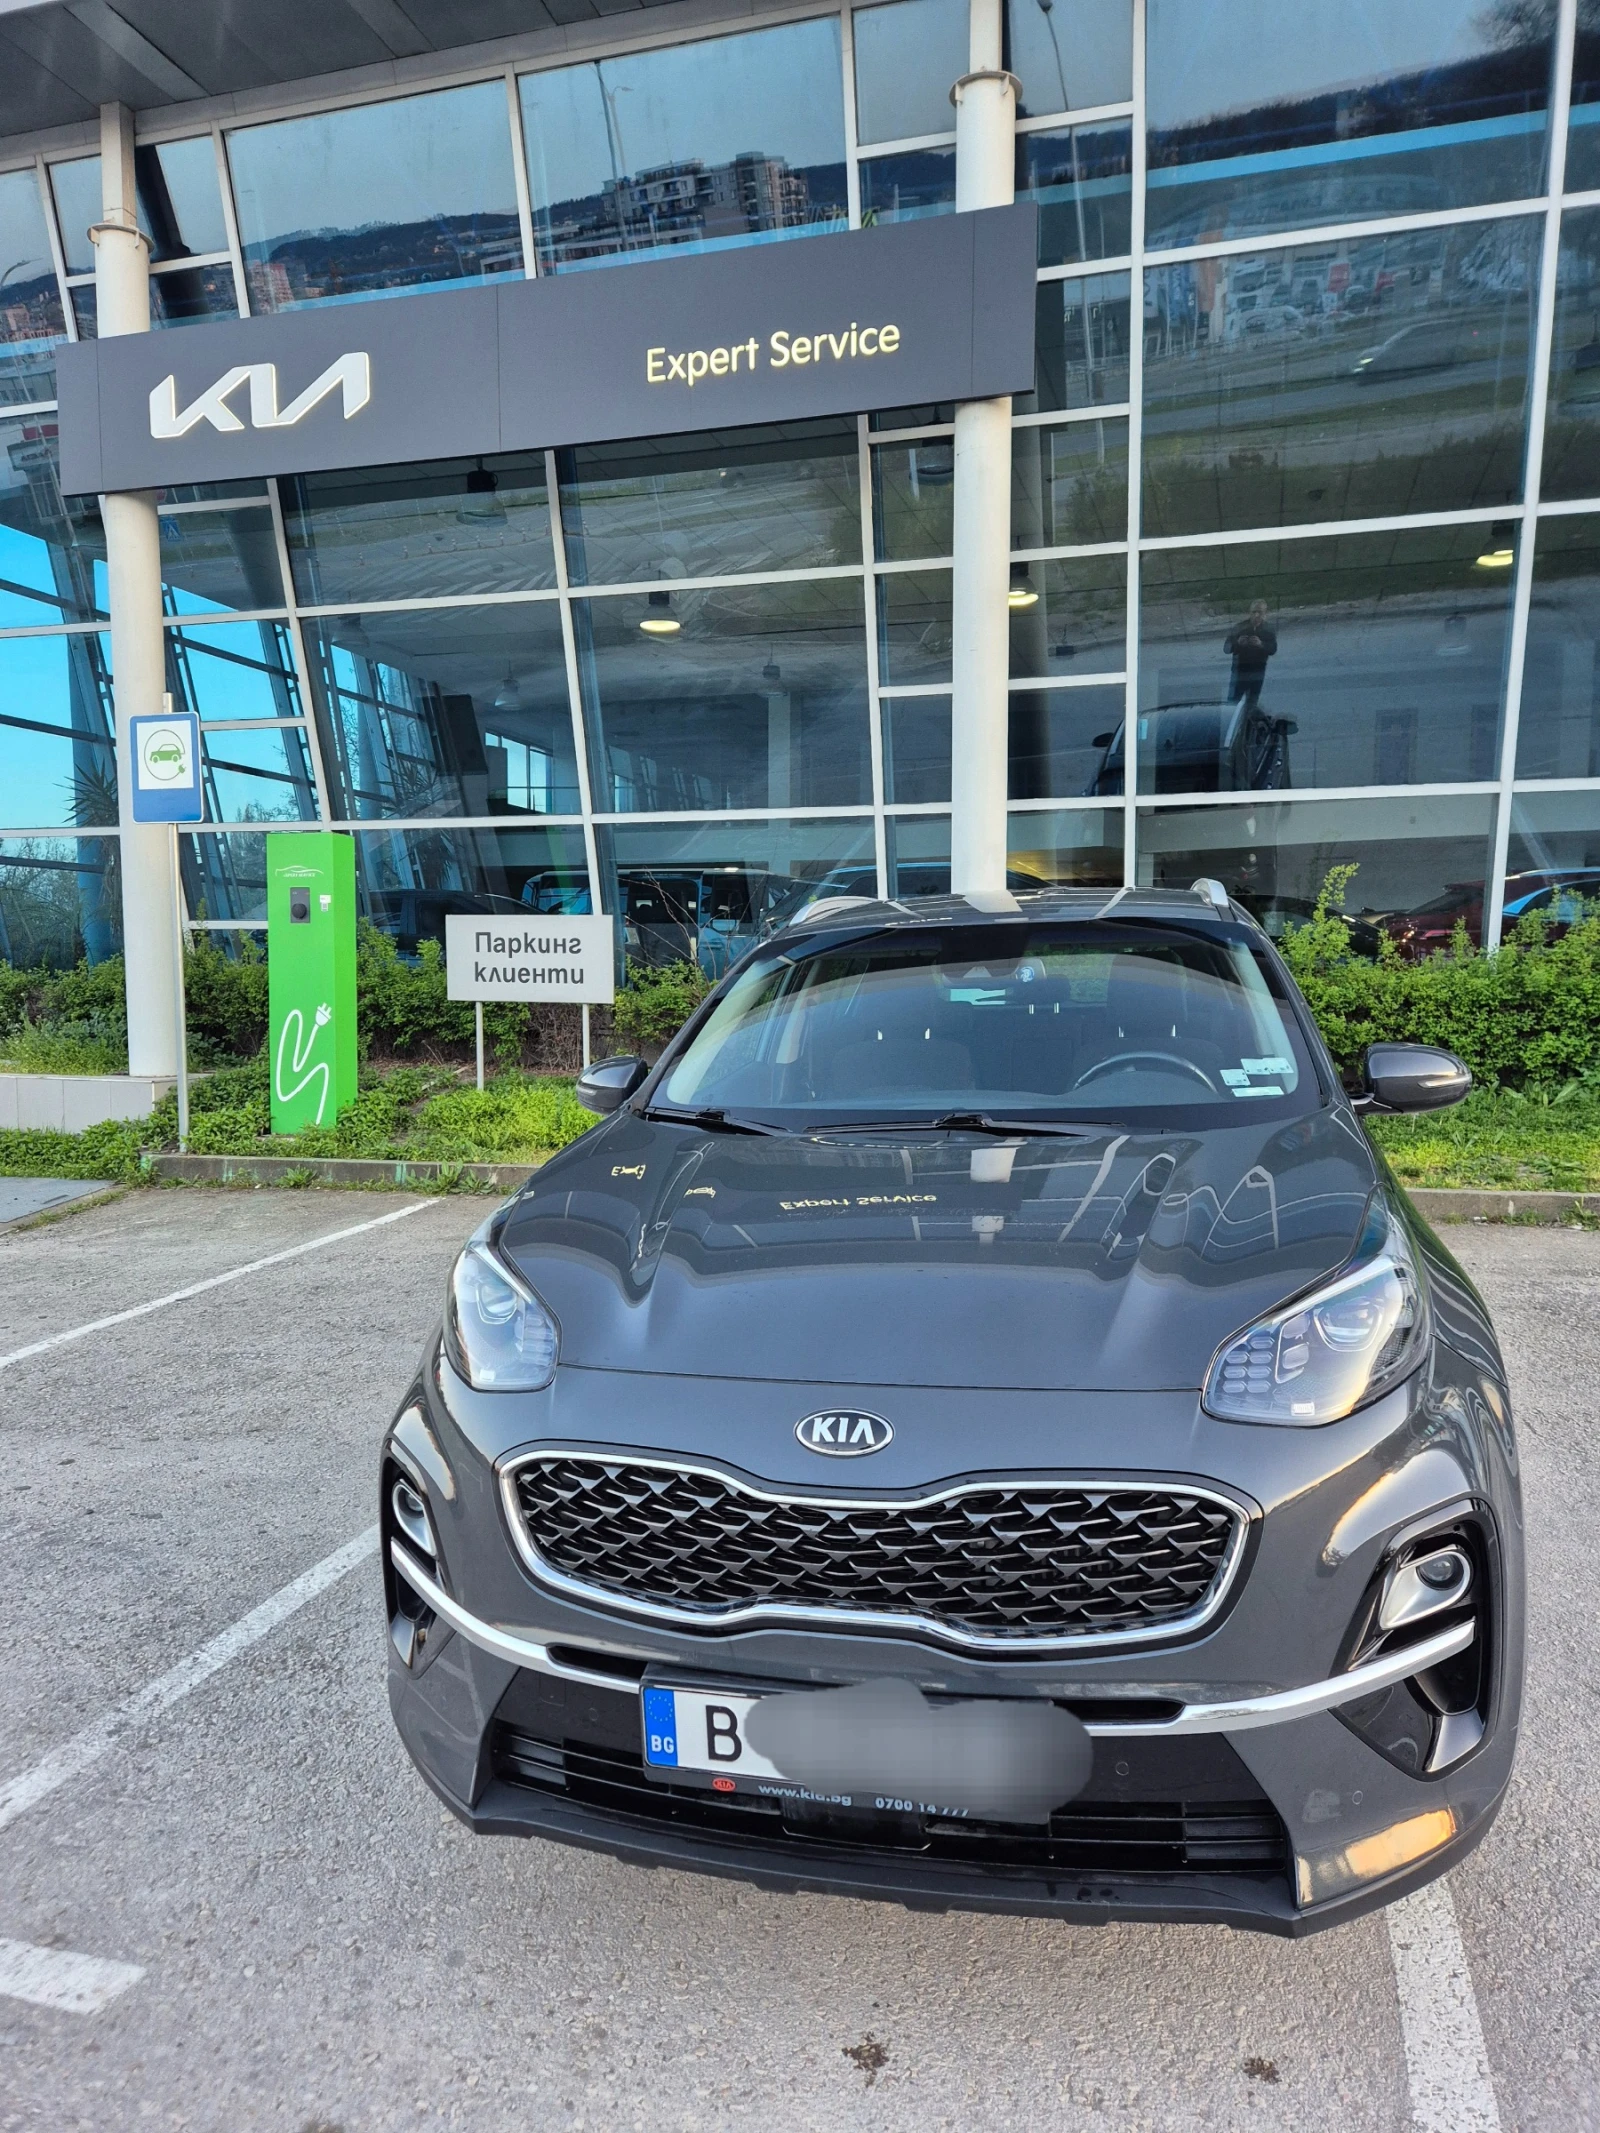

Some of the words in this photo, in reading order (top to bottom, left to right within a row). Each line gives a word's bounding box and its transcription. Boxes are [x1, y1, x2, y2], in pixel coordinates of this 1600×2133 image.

[646, 337, 759, 386] Expert
[770, 322, 900, 367] Service
[475, 931, 582, 958] Паркинг
[474, 961, 584, 984] клиенти
[812, 1417, 875, 1445] KIA
[651, 1734, 675, 1754] BG
[875, 1797, 913, 1811] 0700
[918, 1802, 937, 1814] 14
